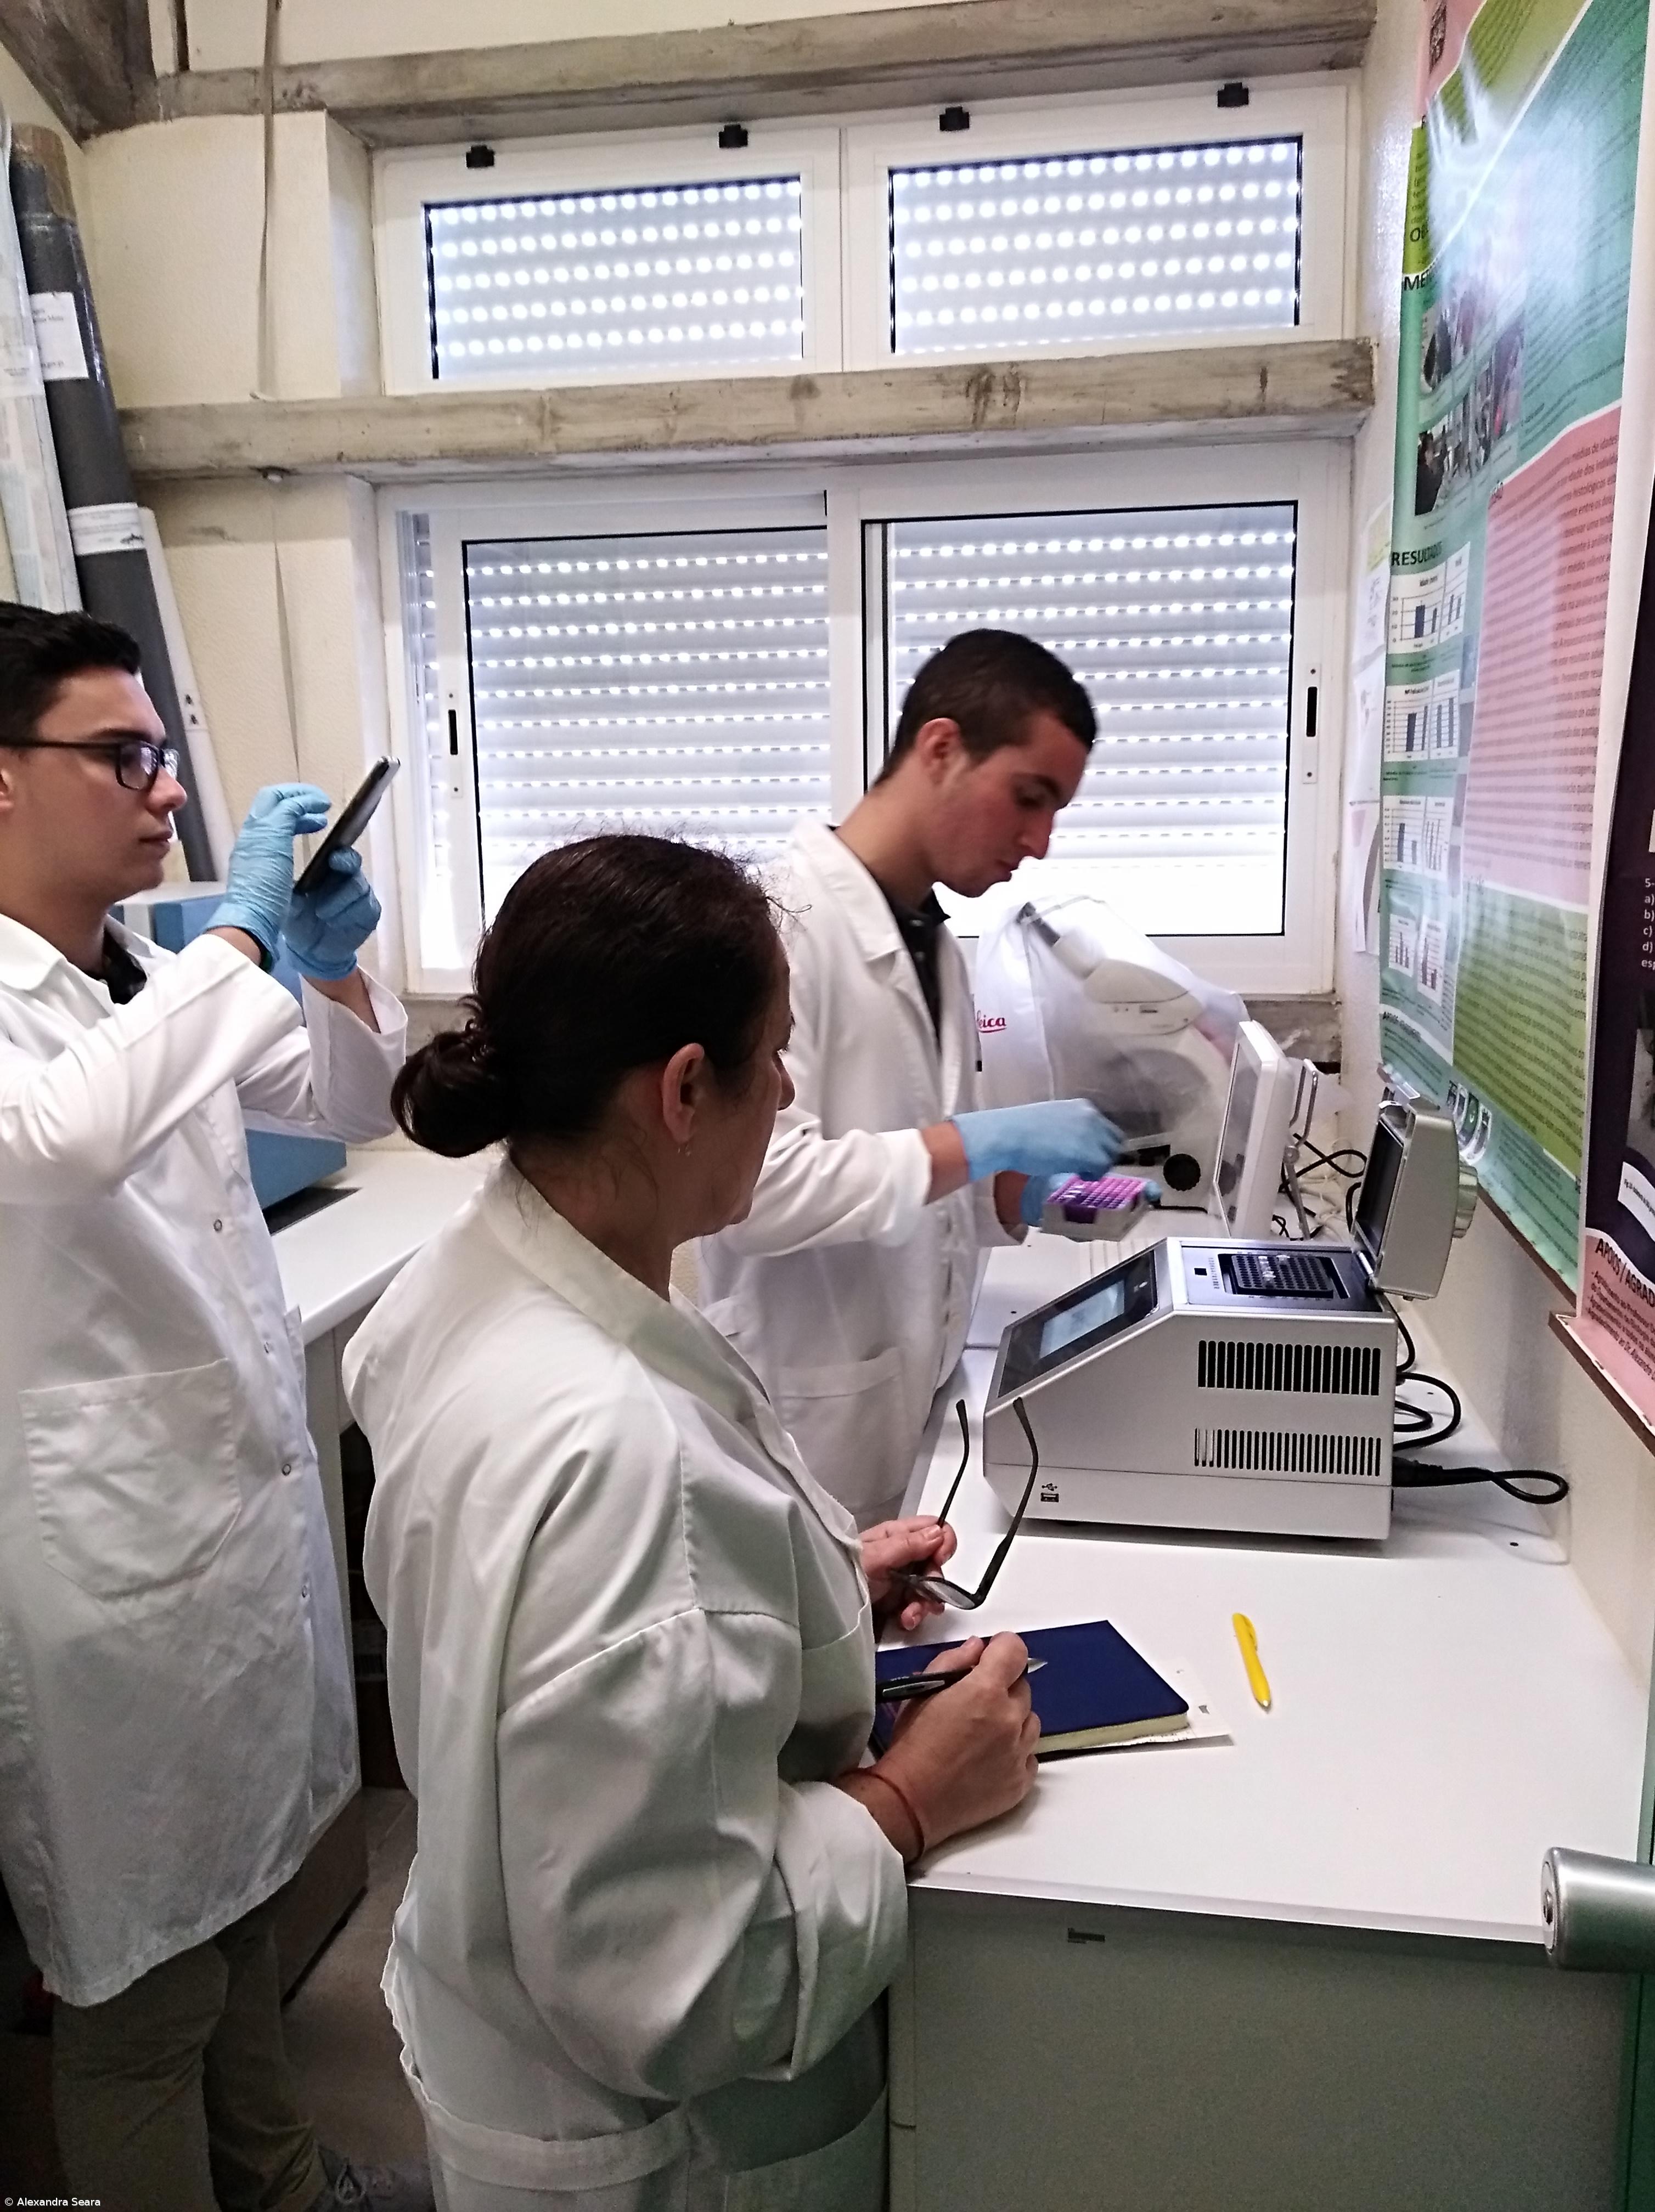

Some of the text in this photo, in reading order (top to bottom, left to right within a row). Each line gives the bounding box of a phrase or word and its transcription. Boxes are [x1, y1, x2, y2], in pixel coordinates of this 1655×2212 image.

[1644, 894, 1654, 906] a)
[1644, 909, 1654, 922] b)
[1643, 926, 1652, 938] c)
[1642, 941, 1653, 953] d)
